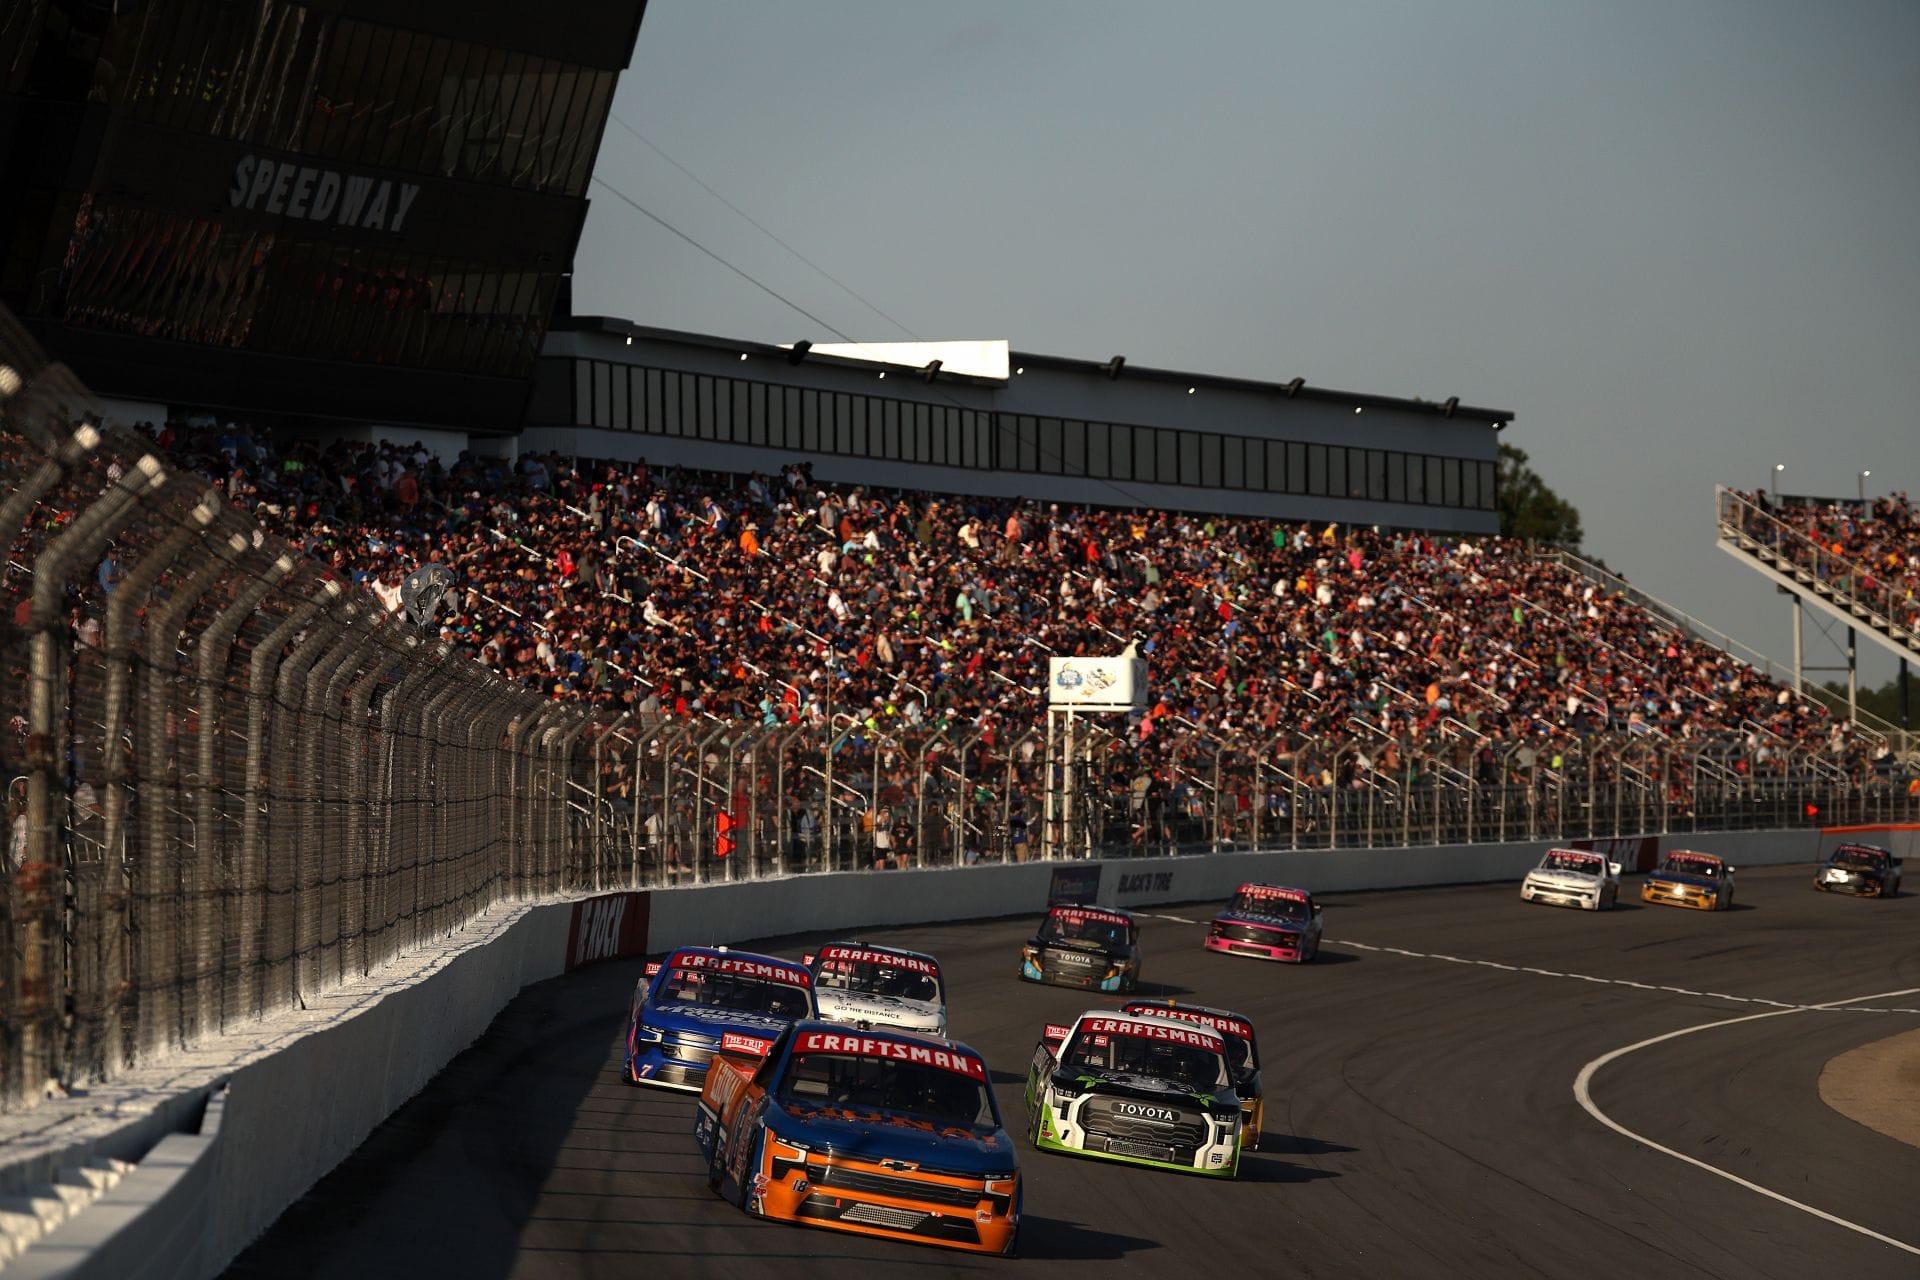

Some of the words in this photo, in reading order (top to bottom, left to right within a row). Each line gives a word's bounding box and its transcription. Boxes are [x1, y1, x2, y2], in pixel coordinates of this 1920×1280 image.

[229, 153, 422, 234] SPEEDWAY
[1055, 909, 1125, 925] CRAFTSMAN
[829, 948, 930, 973] CRAFTSMAN
[1059, 953, 1091, 964] TOYOTA
[681, 955, 801, 985] CRAFTSMAN
[834, 1004, 848, 1012] GO
[850, 1006, 862, 1014] THE
[1133, 1007, 1242, 1034] CRAFTSMAN
[724, 1034, 744, 1046] THE
[744, 1037, 764, 1051] TRIP
[1091, 1019, 1214, 1050] CRAFTSMAN
[807, 1034, 969, 1074] CRAFTSMAN
[639, 1063, 655, 1077] 7
[1119, 1103, 1173, 1121] TOYOTA
[793, 1179, 809, 1192] 18
